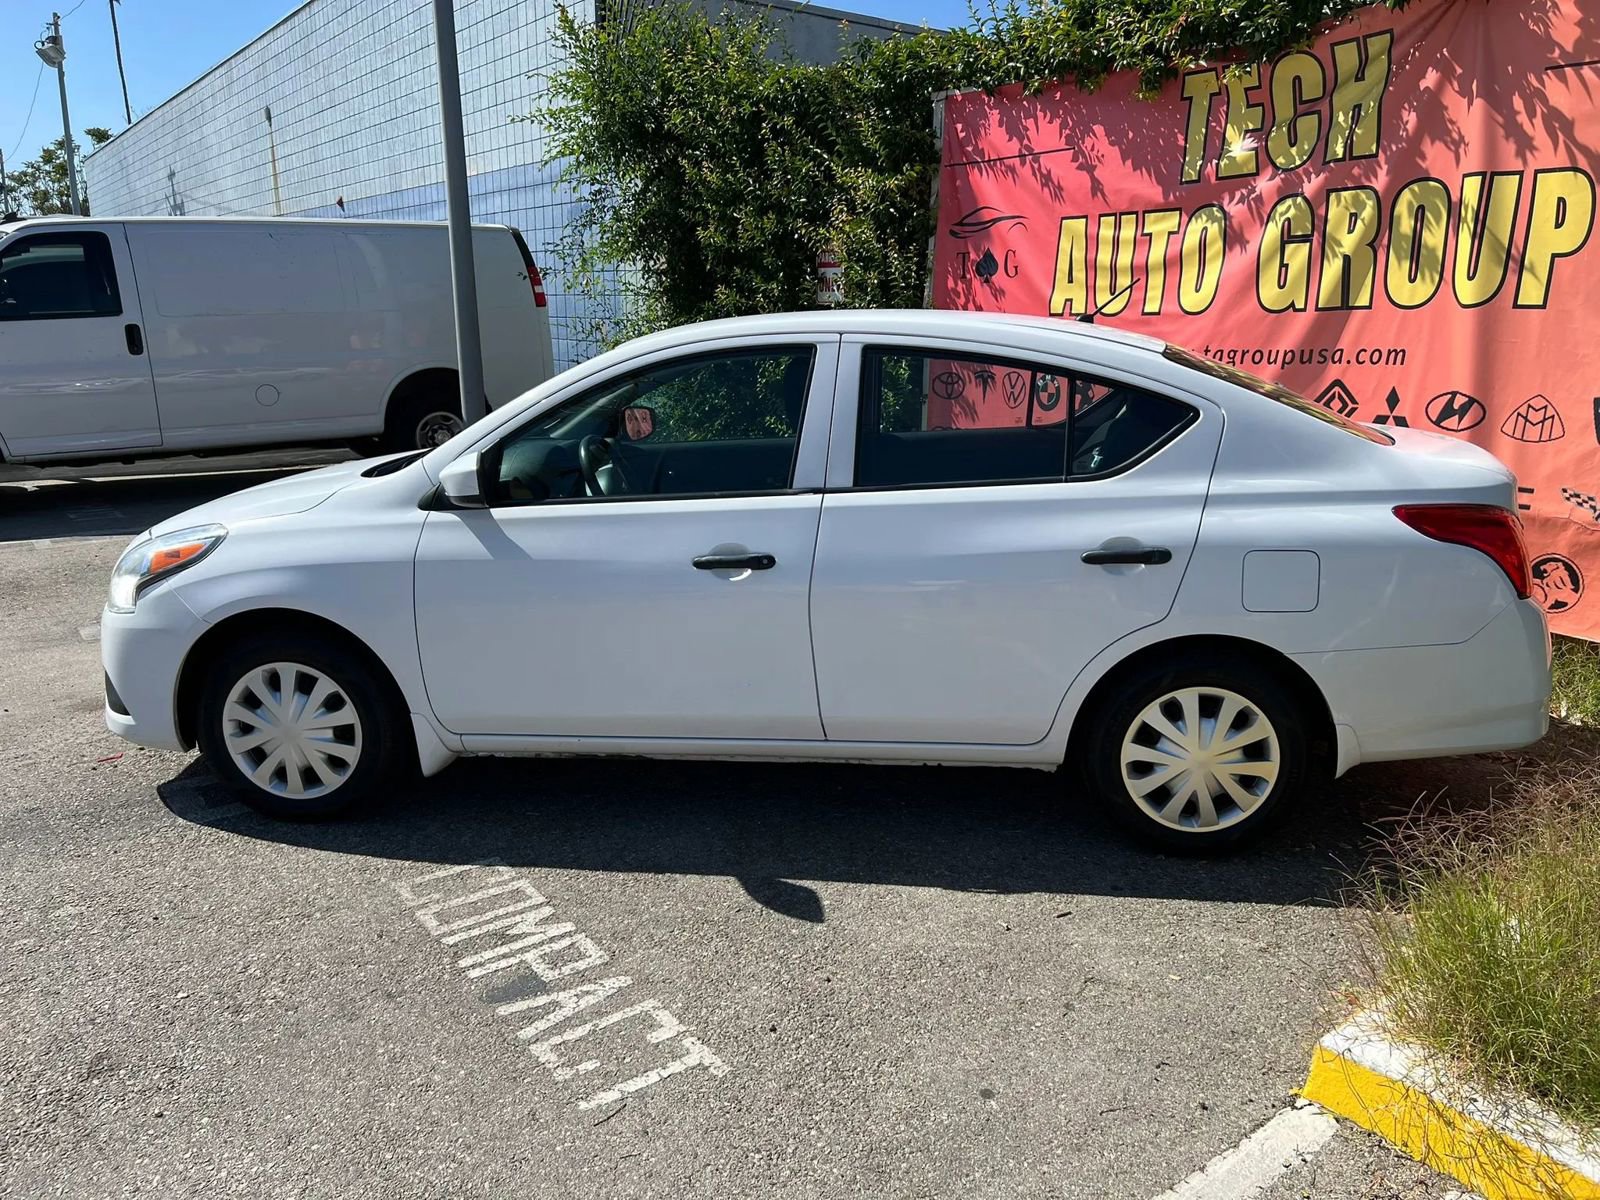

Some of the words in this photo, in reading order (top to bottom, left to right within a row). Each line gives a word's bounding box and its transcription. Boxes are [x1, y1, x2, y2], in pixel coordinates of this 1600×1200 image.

[1180, 28, 1394, 185] TECH
[1049, 203, 1228, 316] AUTO
[1256, 166, 1597, 313] GROUP
[1200, 344, 1407, 370] tagroupusa.com
[396, 859, 731, 1111] COMPACT
